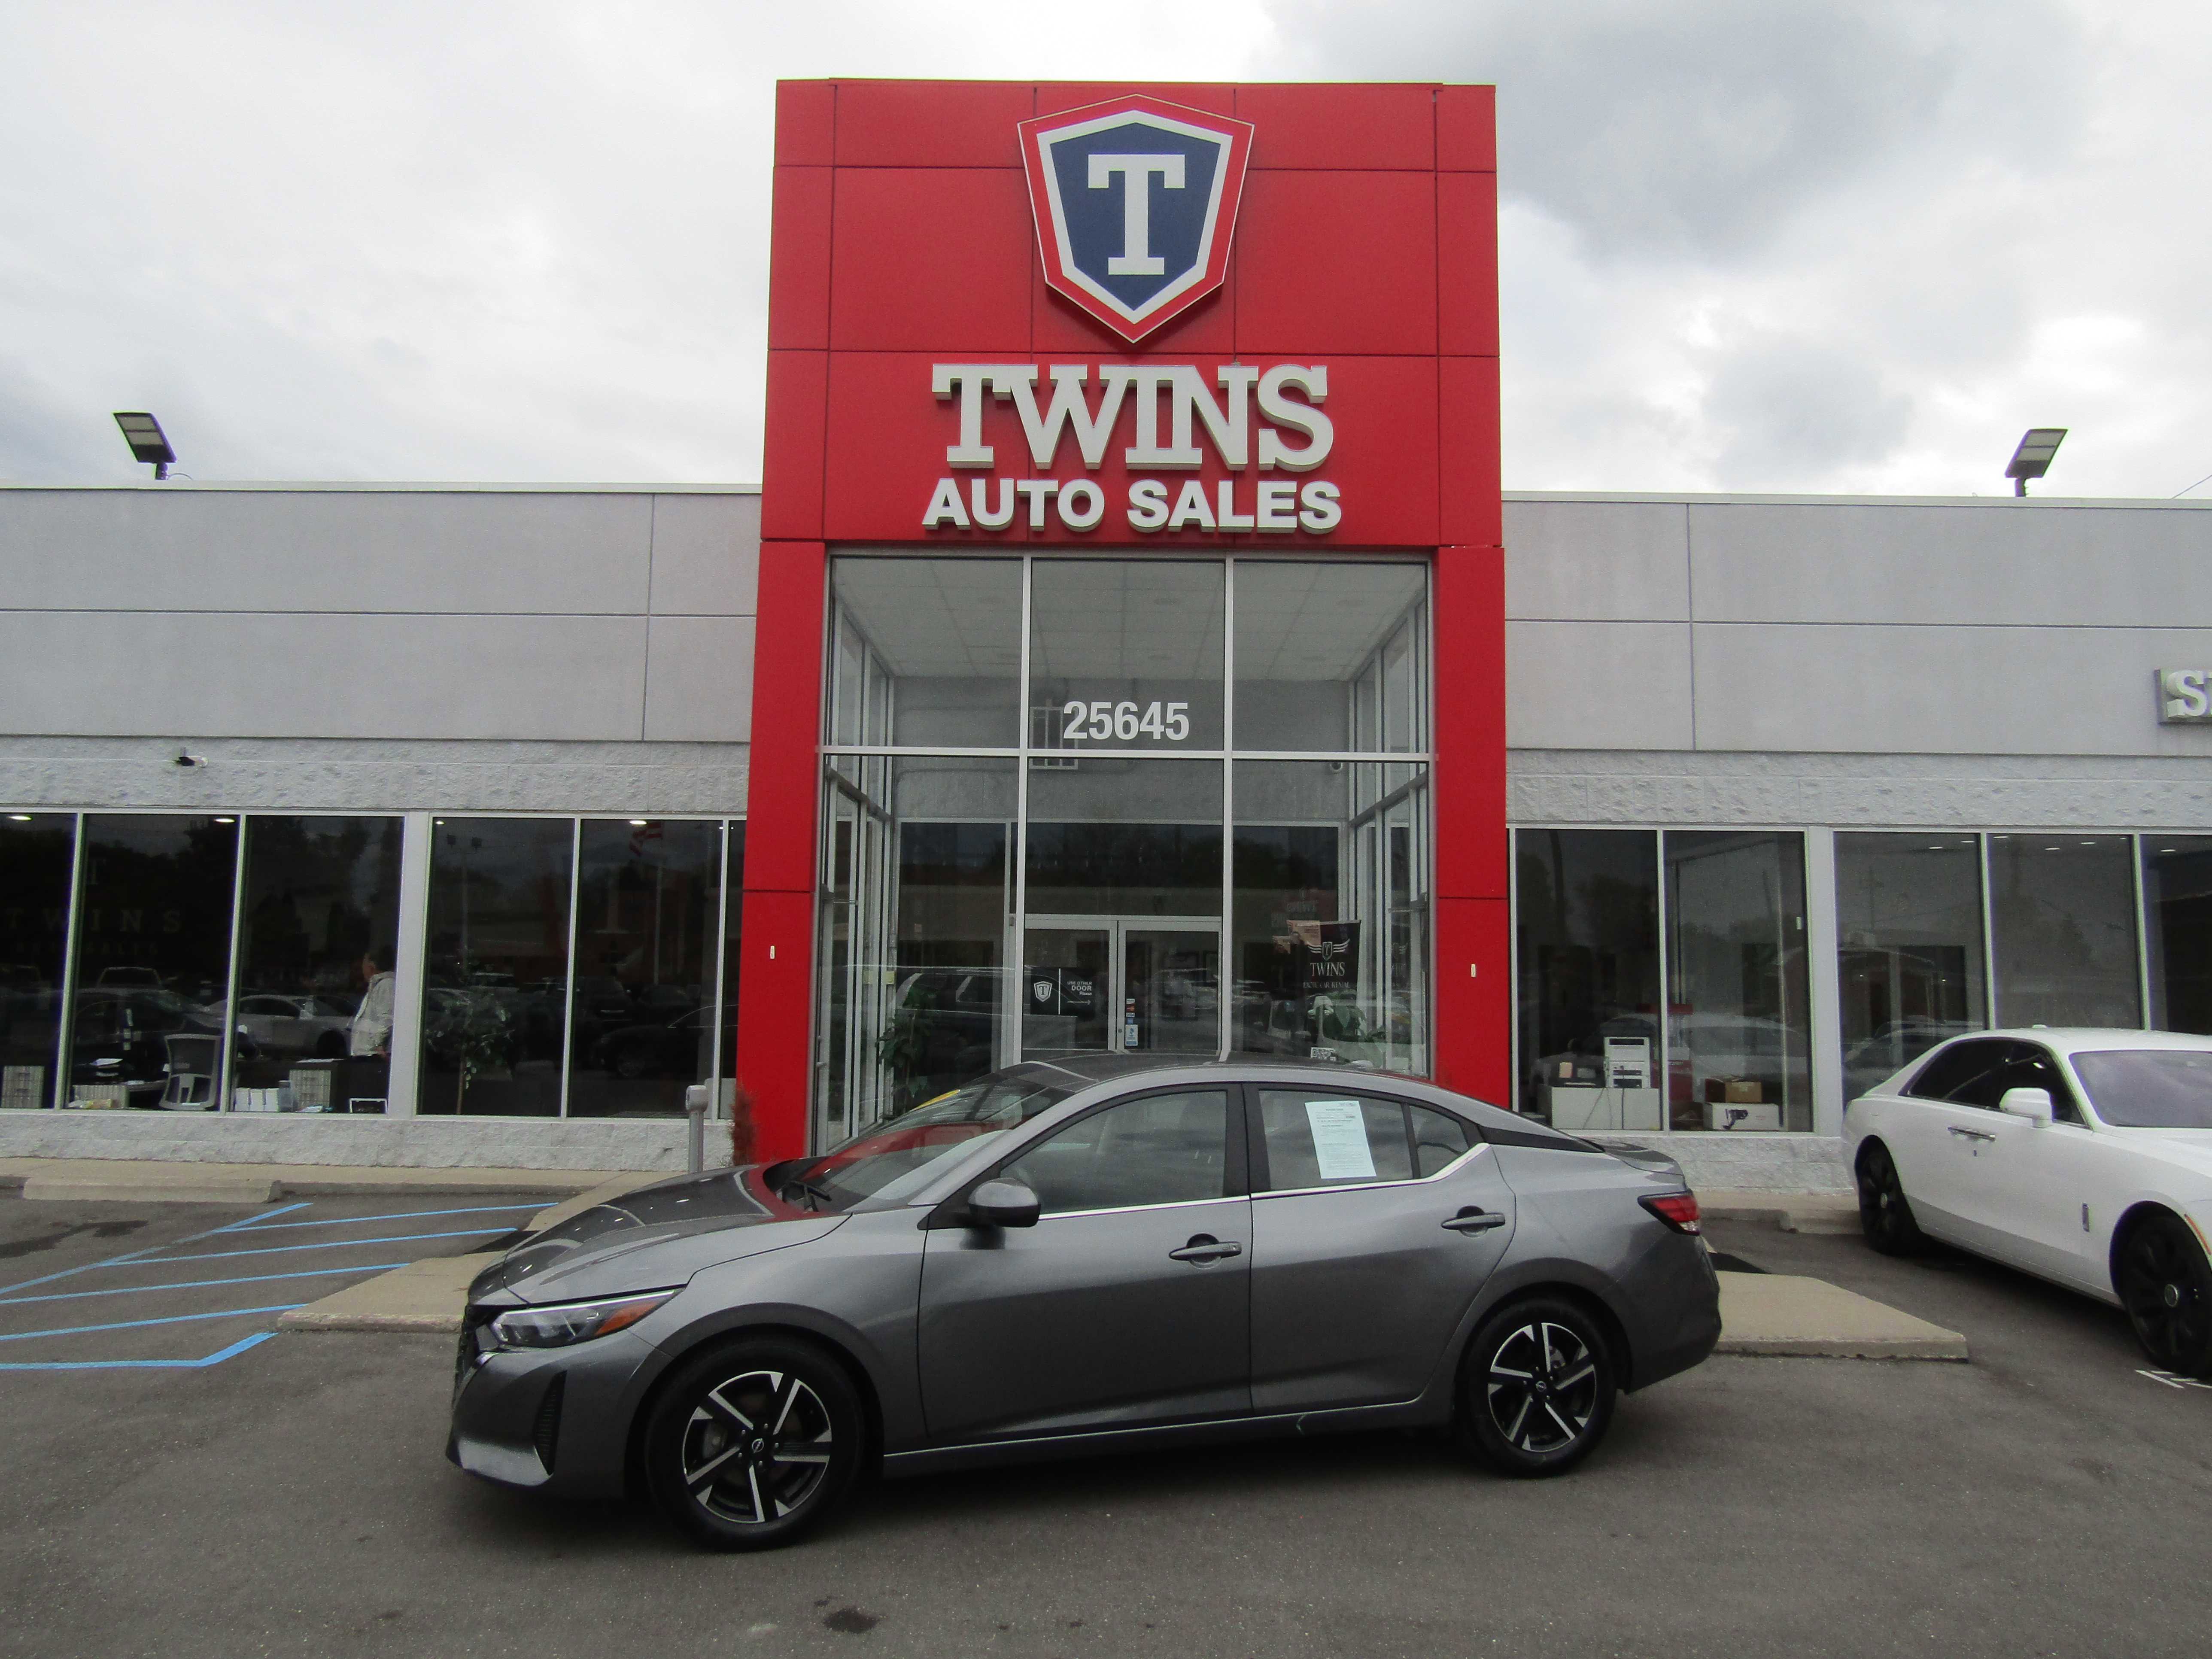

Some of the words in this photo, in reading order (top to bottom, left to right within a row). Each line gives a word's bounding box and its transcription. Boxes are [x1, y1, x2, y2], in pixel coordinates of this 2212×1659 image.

[1088, 153, 1185, 276] T
[932, 363, 1334, 472] TWINS
[922, 477, 1105, 532] AUTO
[1127, 479, 1342, 534] SALES
[2167, 670, 2212, 717] S
[1063, 701, 1189, 741] 25645
[1310, 962, 1345, 976] TWINS
